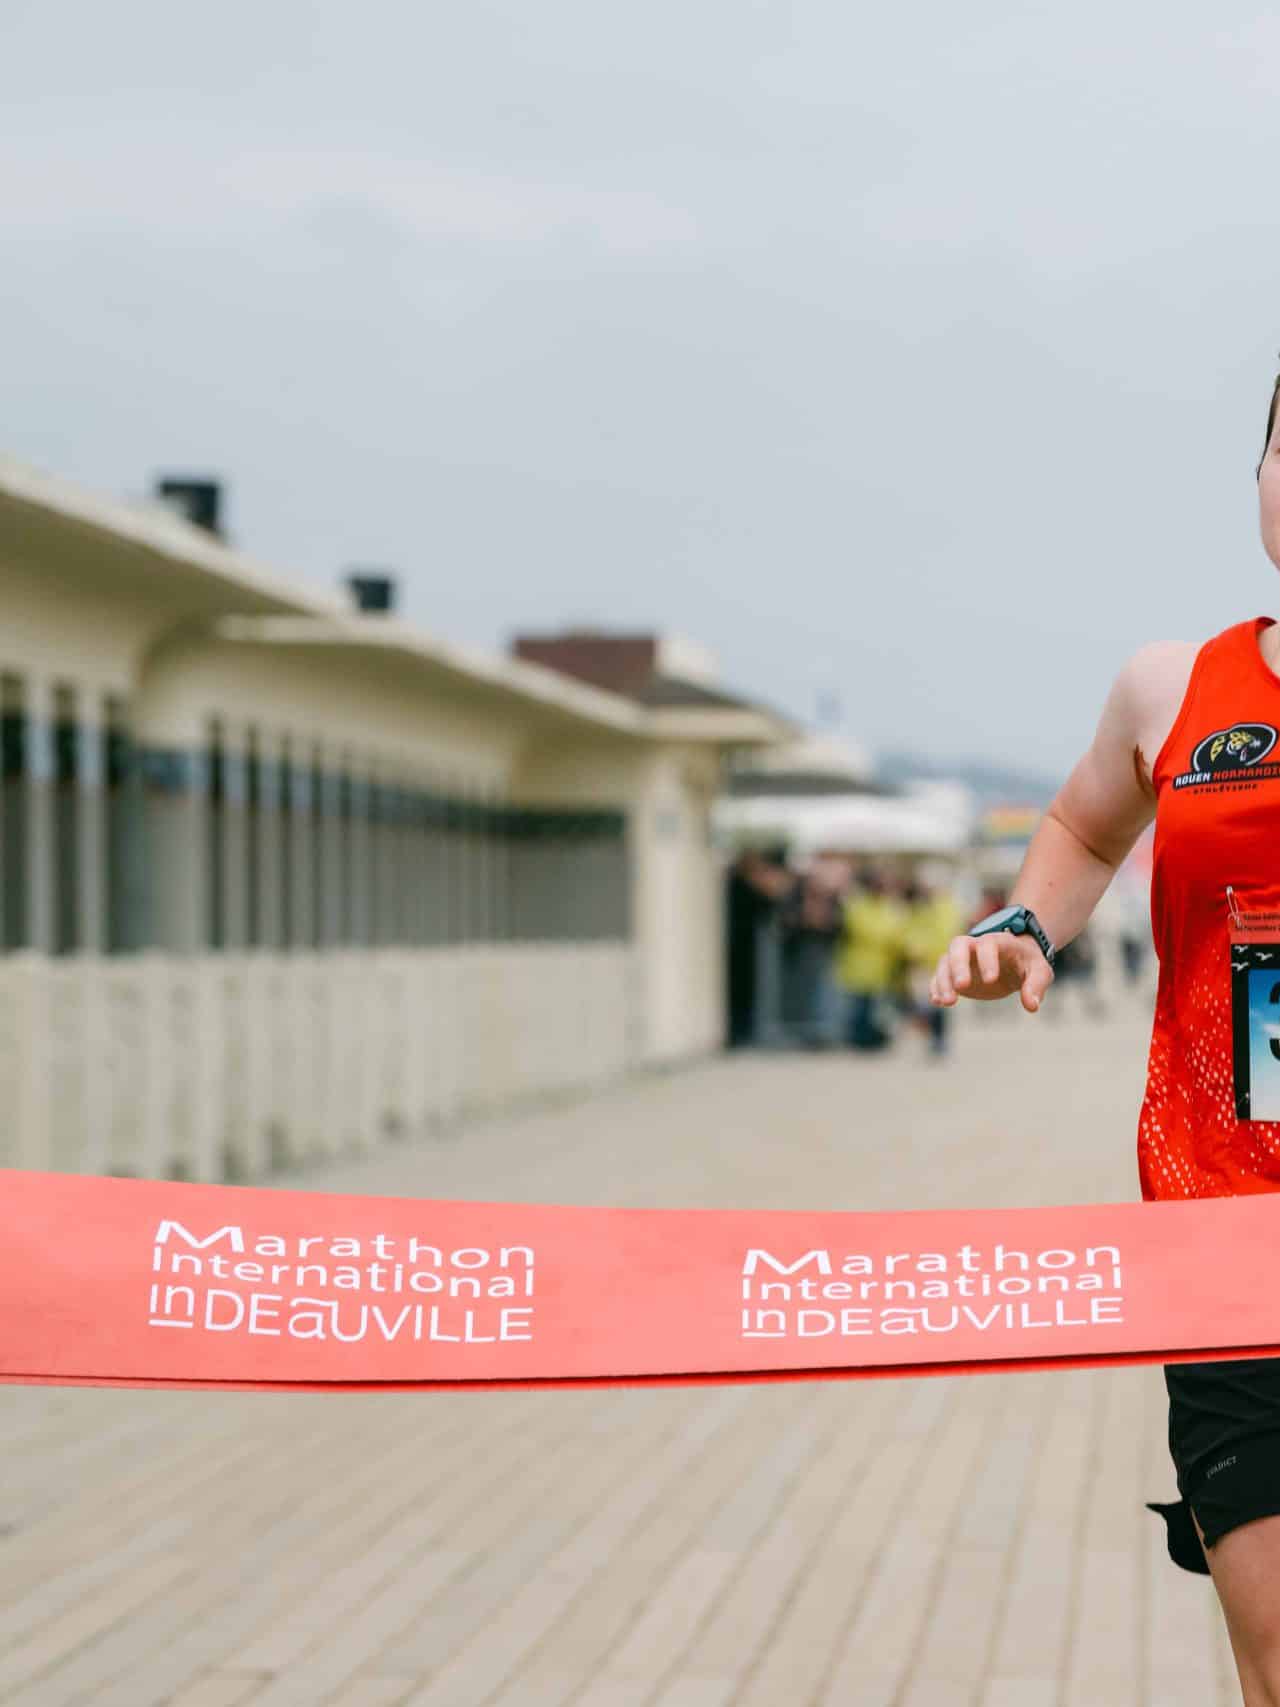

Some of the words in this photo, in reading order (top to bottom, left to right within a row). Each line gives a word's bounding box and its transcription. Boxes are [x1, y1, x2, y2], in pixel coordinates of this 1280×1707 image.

[1175, 772, 1211, 788] ROUEN
[154, 1219, 536, 1271] Marathon
[741, 1244, 1122, 1276] Marathon
[152, 1246, 535, 1299] International
[742, 1266, 1123, 1302] International
